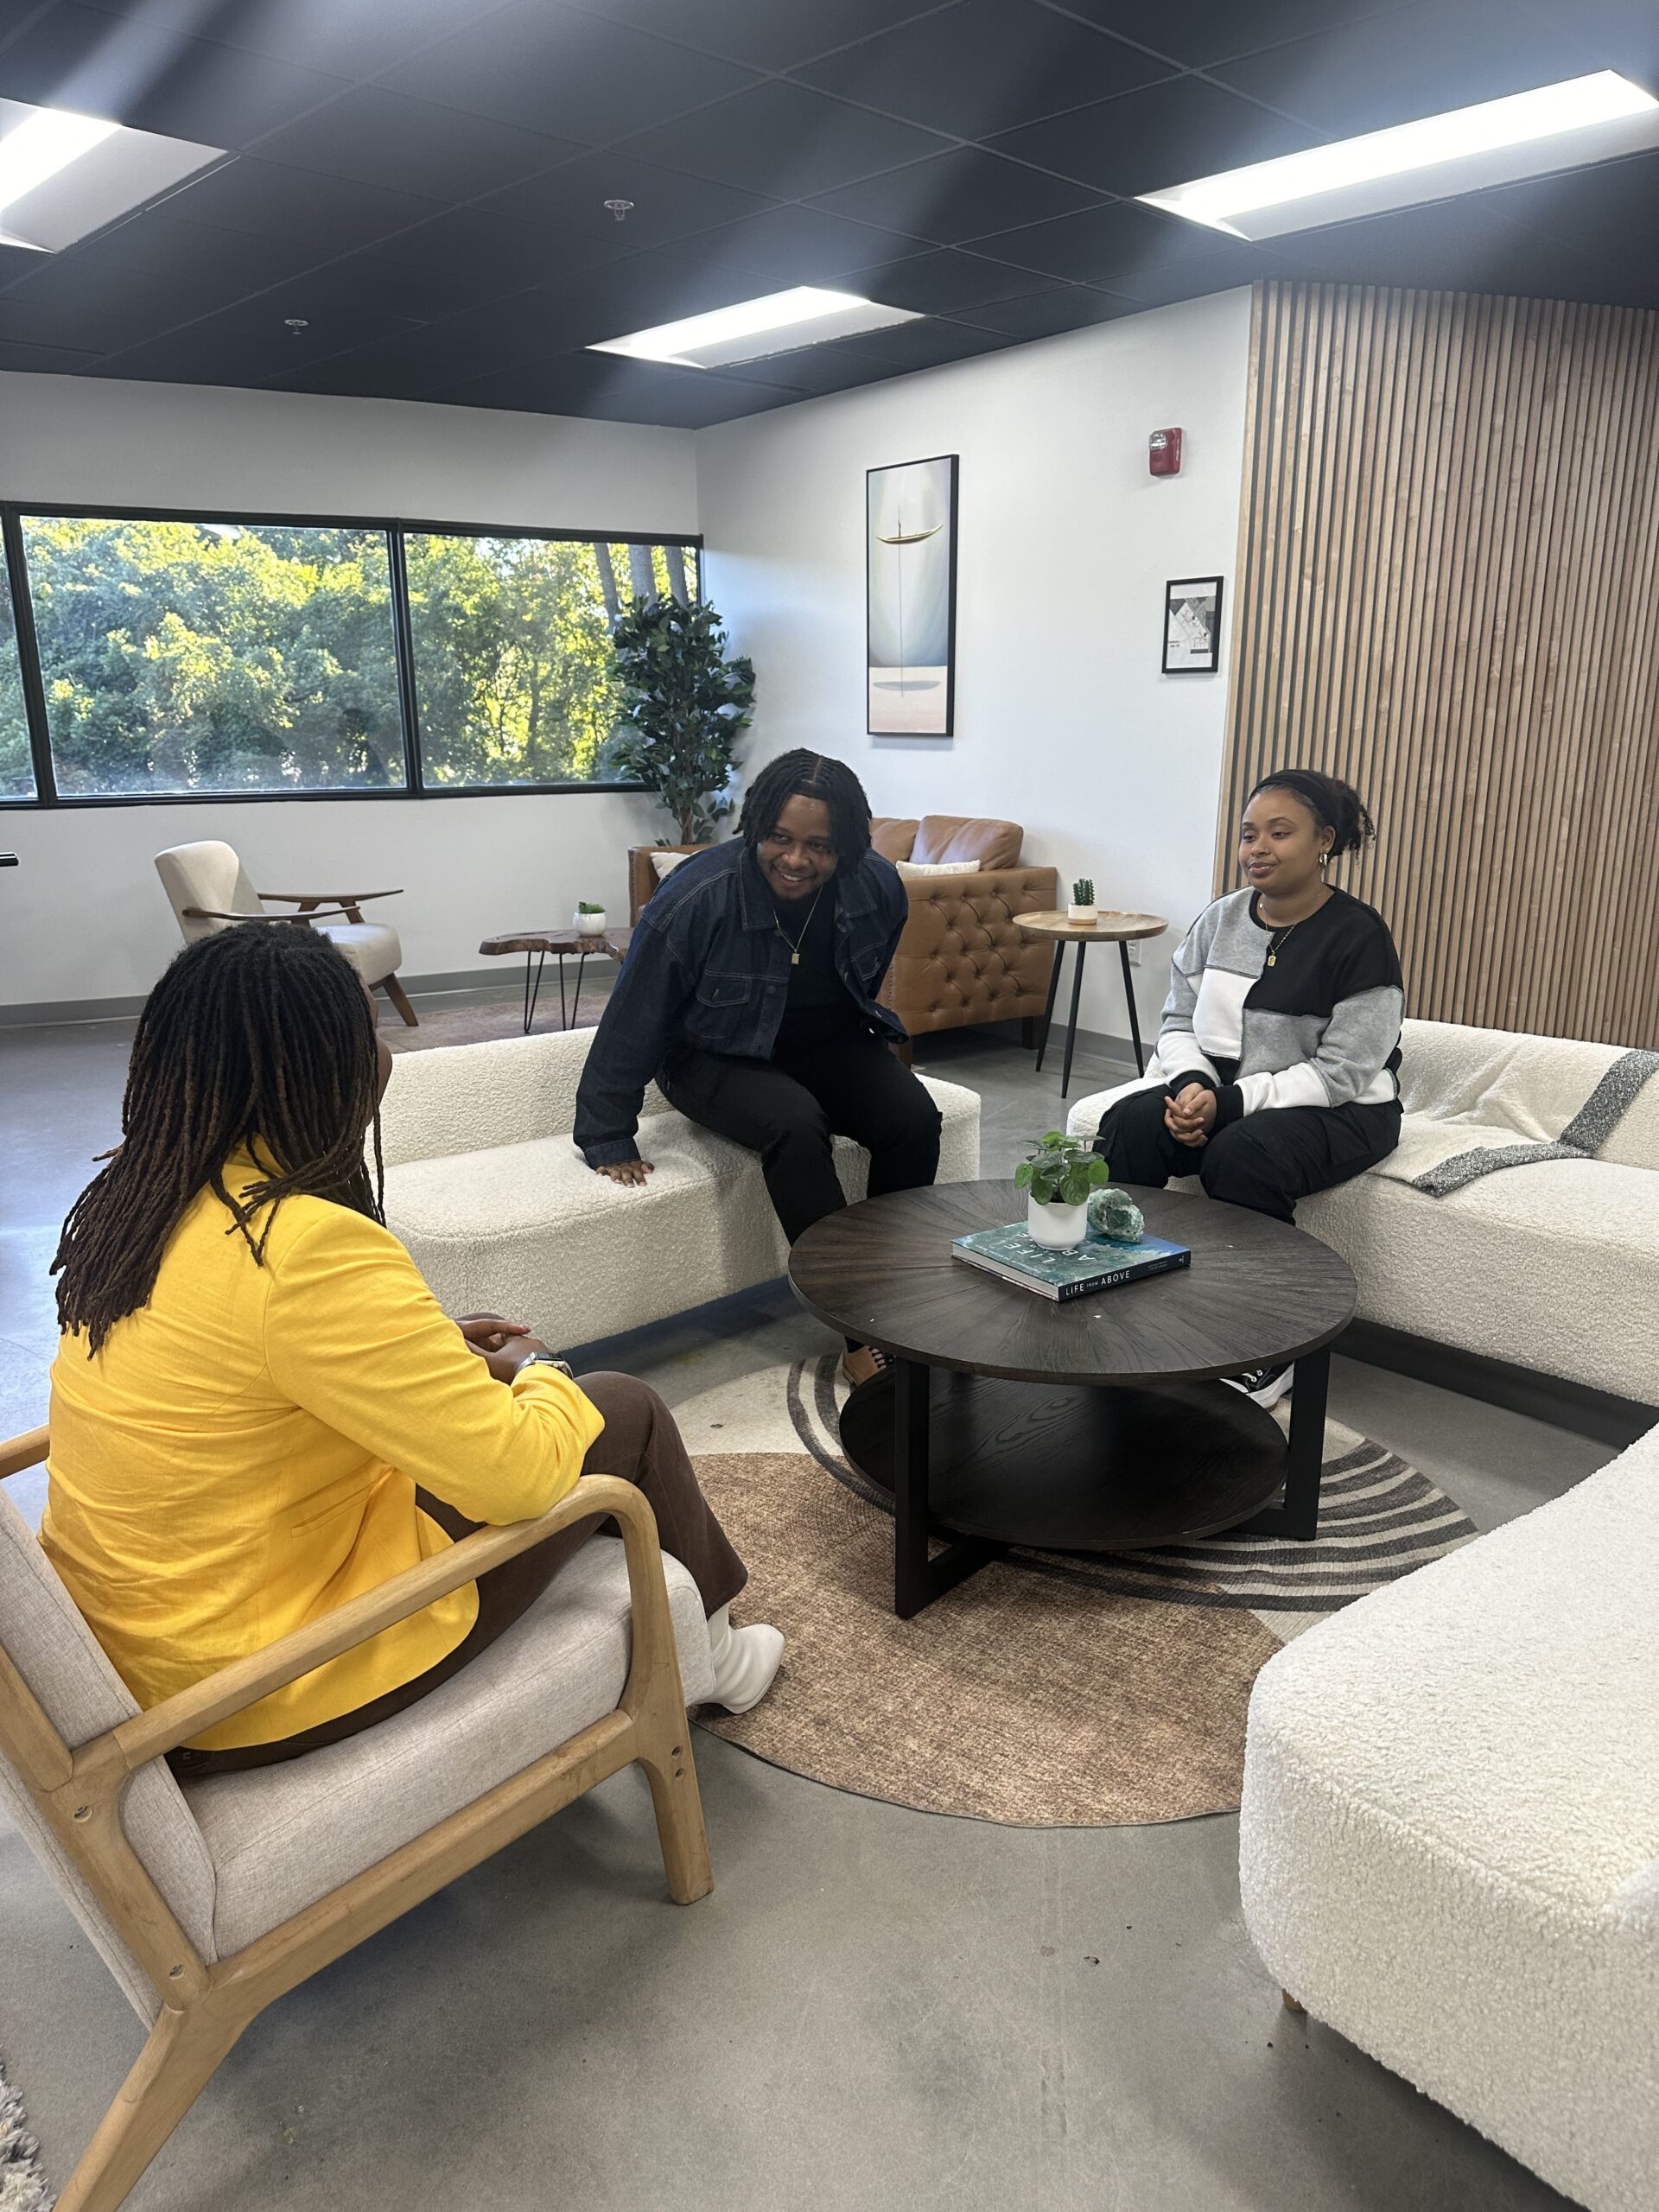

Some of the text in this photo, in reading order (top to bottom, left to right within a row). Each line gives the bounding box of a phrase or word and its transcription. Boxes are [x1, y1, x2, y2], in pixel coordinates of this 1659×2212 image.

[1003, 1242, 1056, 1263] LIFE
[1065, 1283, 1084, 1296] LIFE
[1101, 1270, 1130, 1286] ABOVE
